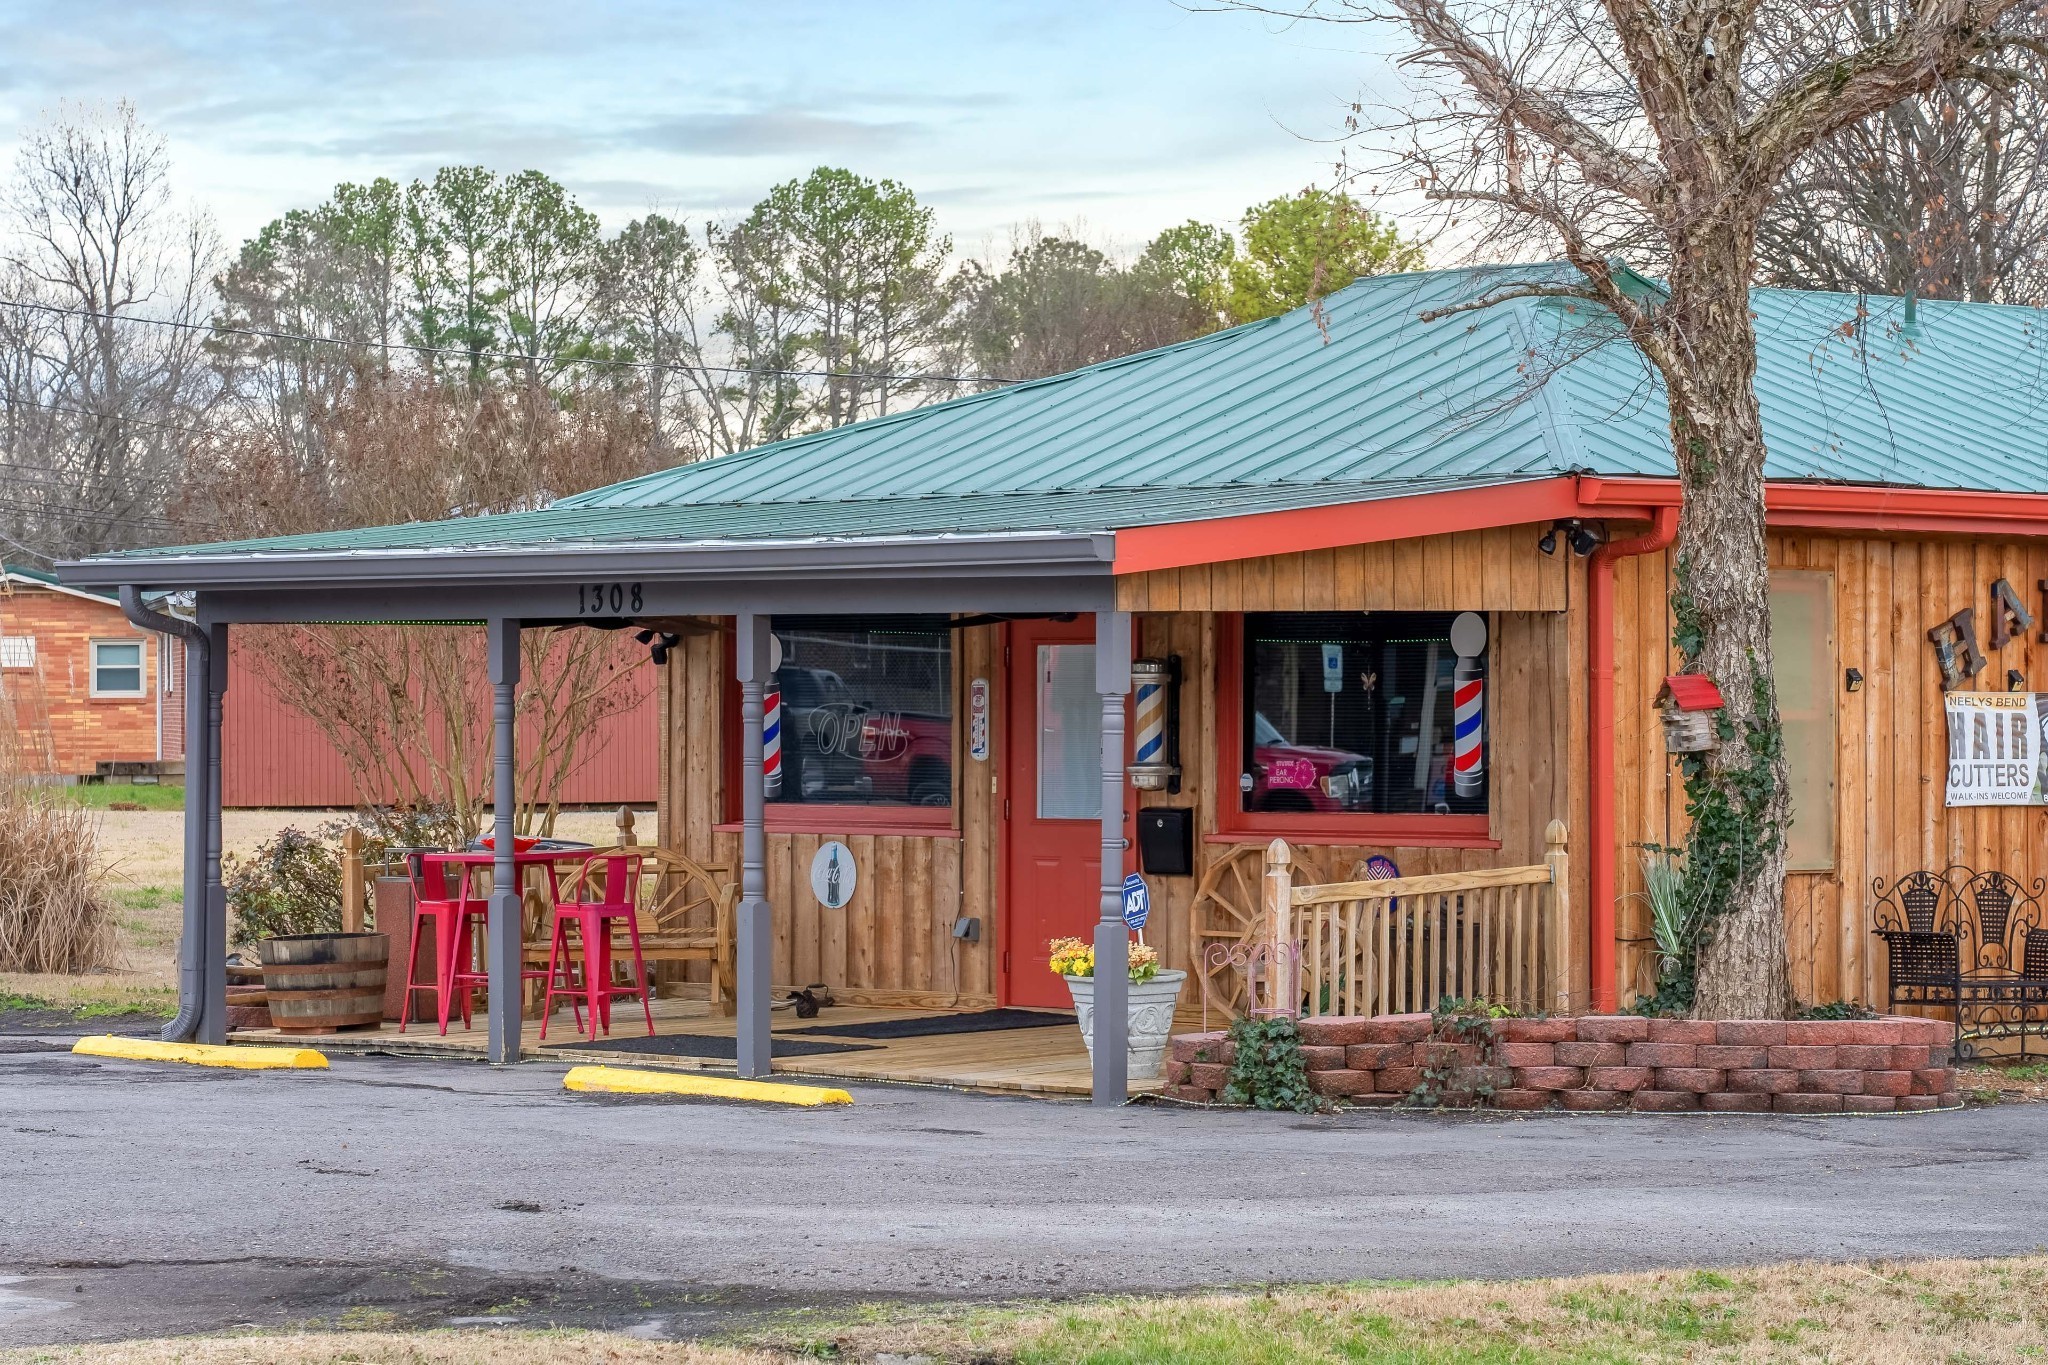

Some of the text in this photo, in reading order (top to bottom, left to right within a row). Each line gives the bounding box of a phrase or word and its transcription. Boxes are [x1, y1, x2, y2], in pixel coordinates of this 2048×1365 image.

[579, 582, 643, 614] 1308
[1949, 696, 2027, 707] NEELYS BEND
[817, 711, 901, 755] OPEN
[1947, 711, 2028, 760] HAIR
[1275, 768, 1288, 776] EAR
[1950, 763, 2030, 788] CUTTERS
[1950, 791, 2028, 801] WALK-INS WELCOME
[1126, 888, 1145, 915] ADT
